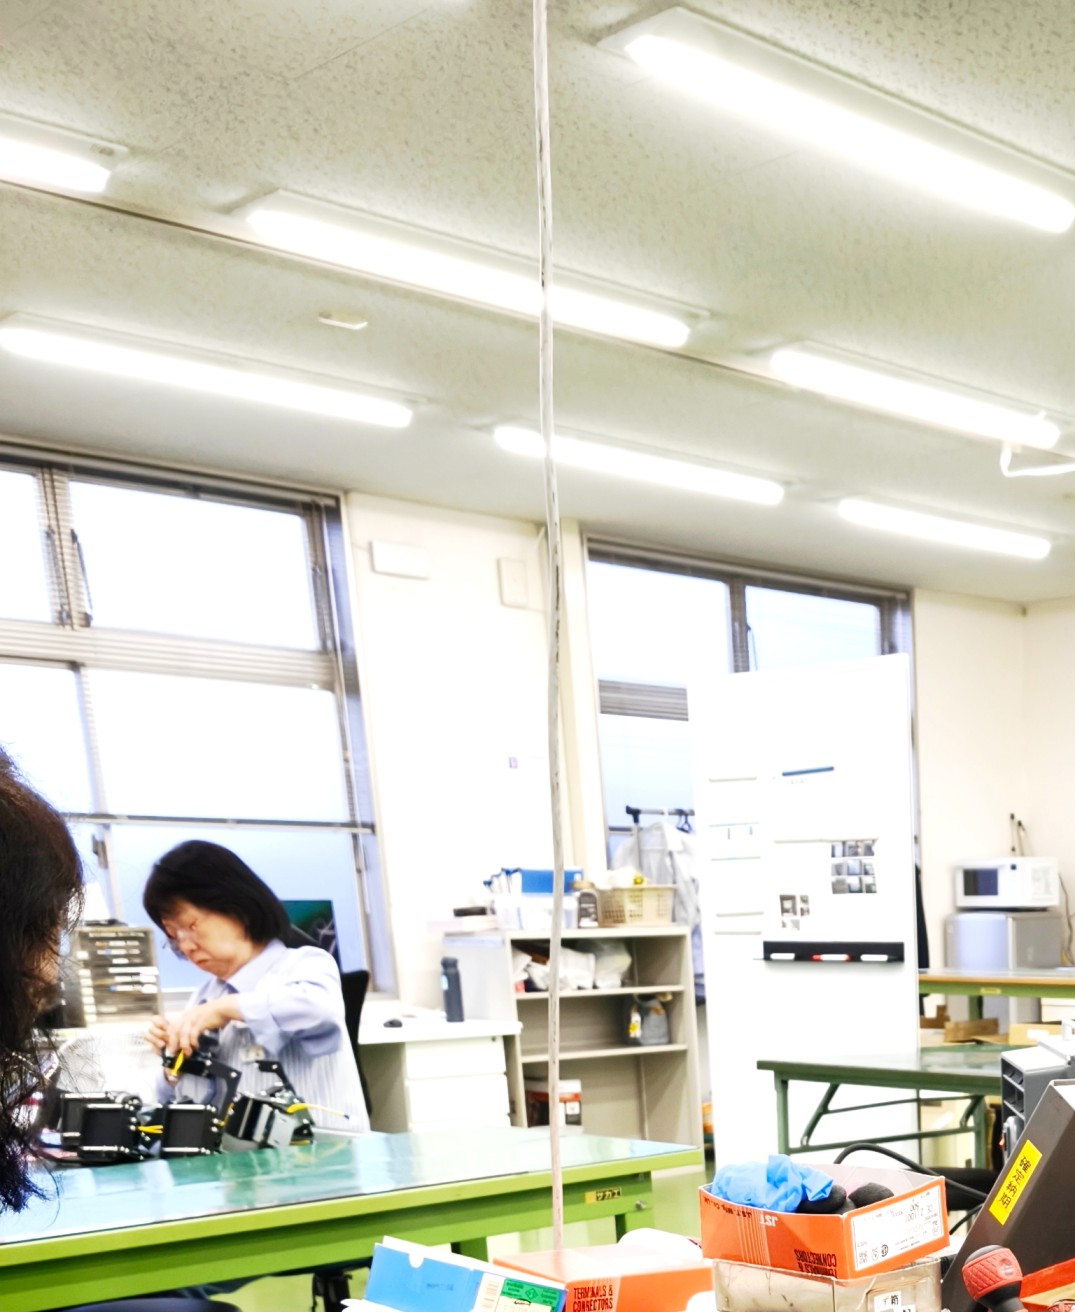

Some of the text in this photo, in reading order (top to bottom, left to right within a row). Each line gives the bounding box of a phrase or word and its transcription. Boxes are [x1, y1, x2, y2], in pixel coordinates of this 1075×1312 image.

[999, 1156, 1032, 1209] 確定納期
[597, 1188, 621, 1201] サカエ
[760, 1213, 778, 1227] JST
[794, 1248, 837, 1268] CONNECTORS
[574, 1285, 607, 1300] TERMINALS
